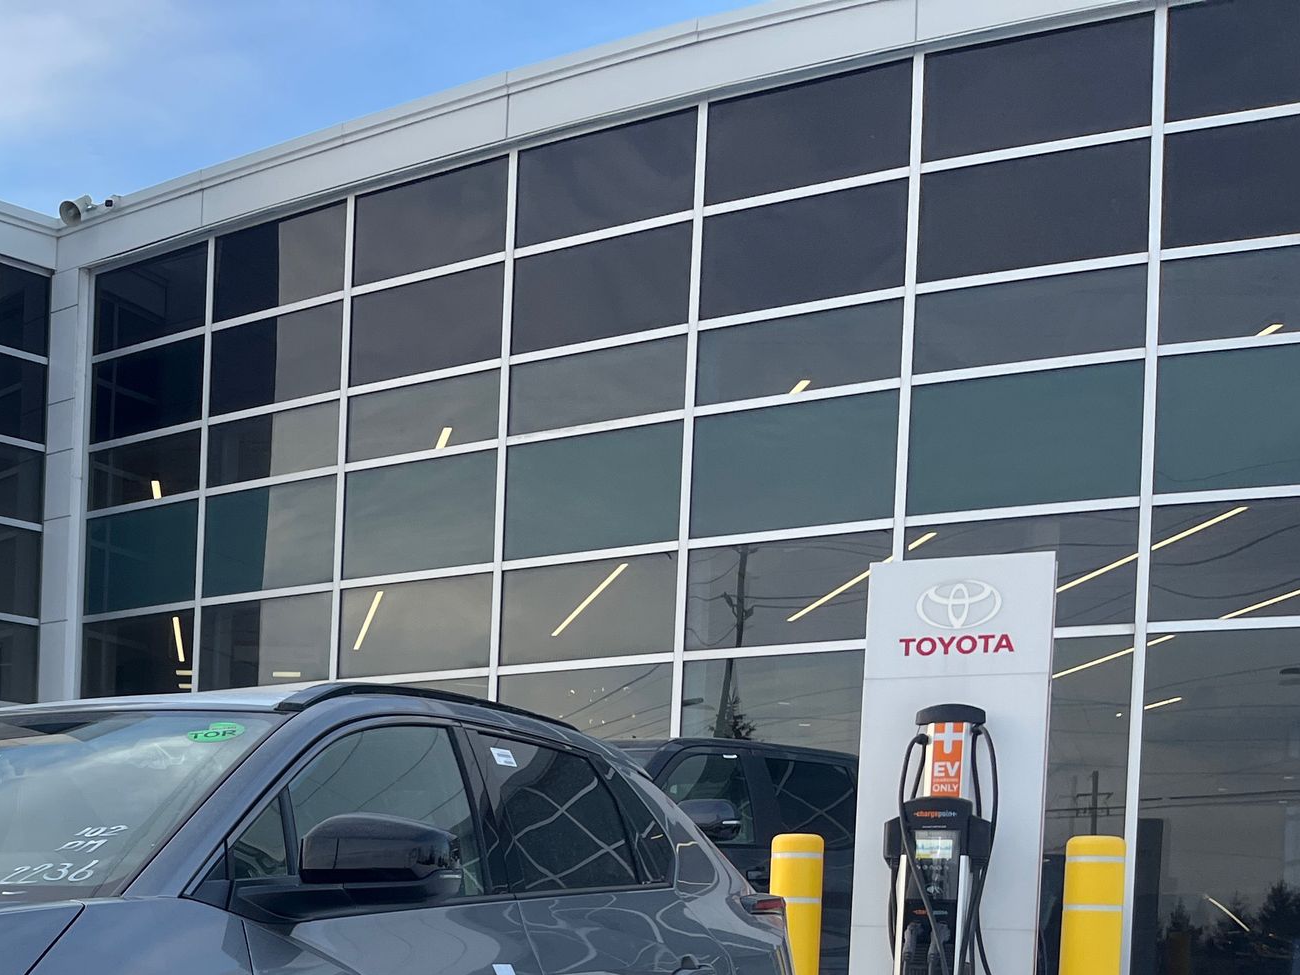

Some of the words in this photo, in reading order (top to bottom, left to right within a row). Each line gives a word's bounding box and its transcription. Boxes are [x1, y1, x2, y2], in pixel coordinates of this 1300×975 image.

[899, 634, 1015, 656] TOYOTA
[190, 730, 237, 739] TOR
[933, 761, 960, 777] EV
[932, 783, 959, 792] ONLY
[0, 859, 99, 885] 2236
